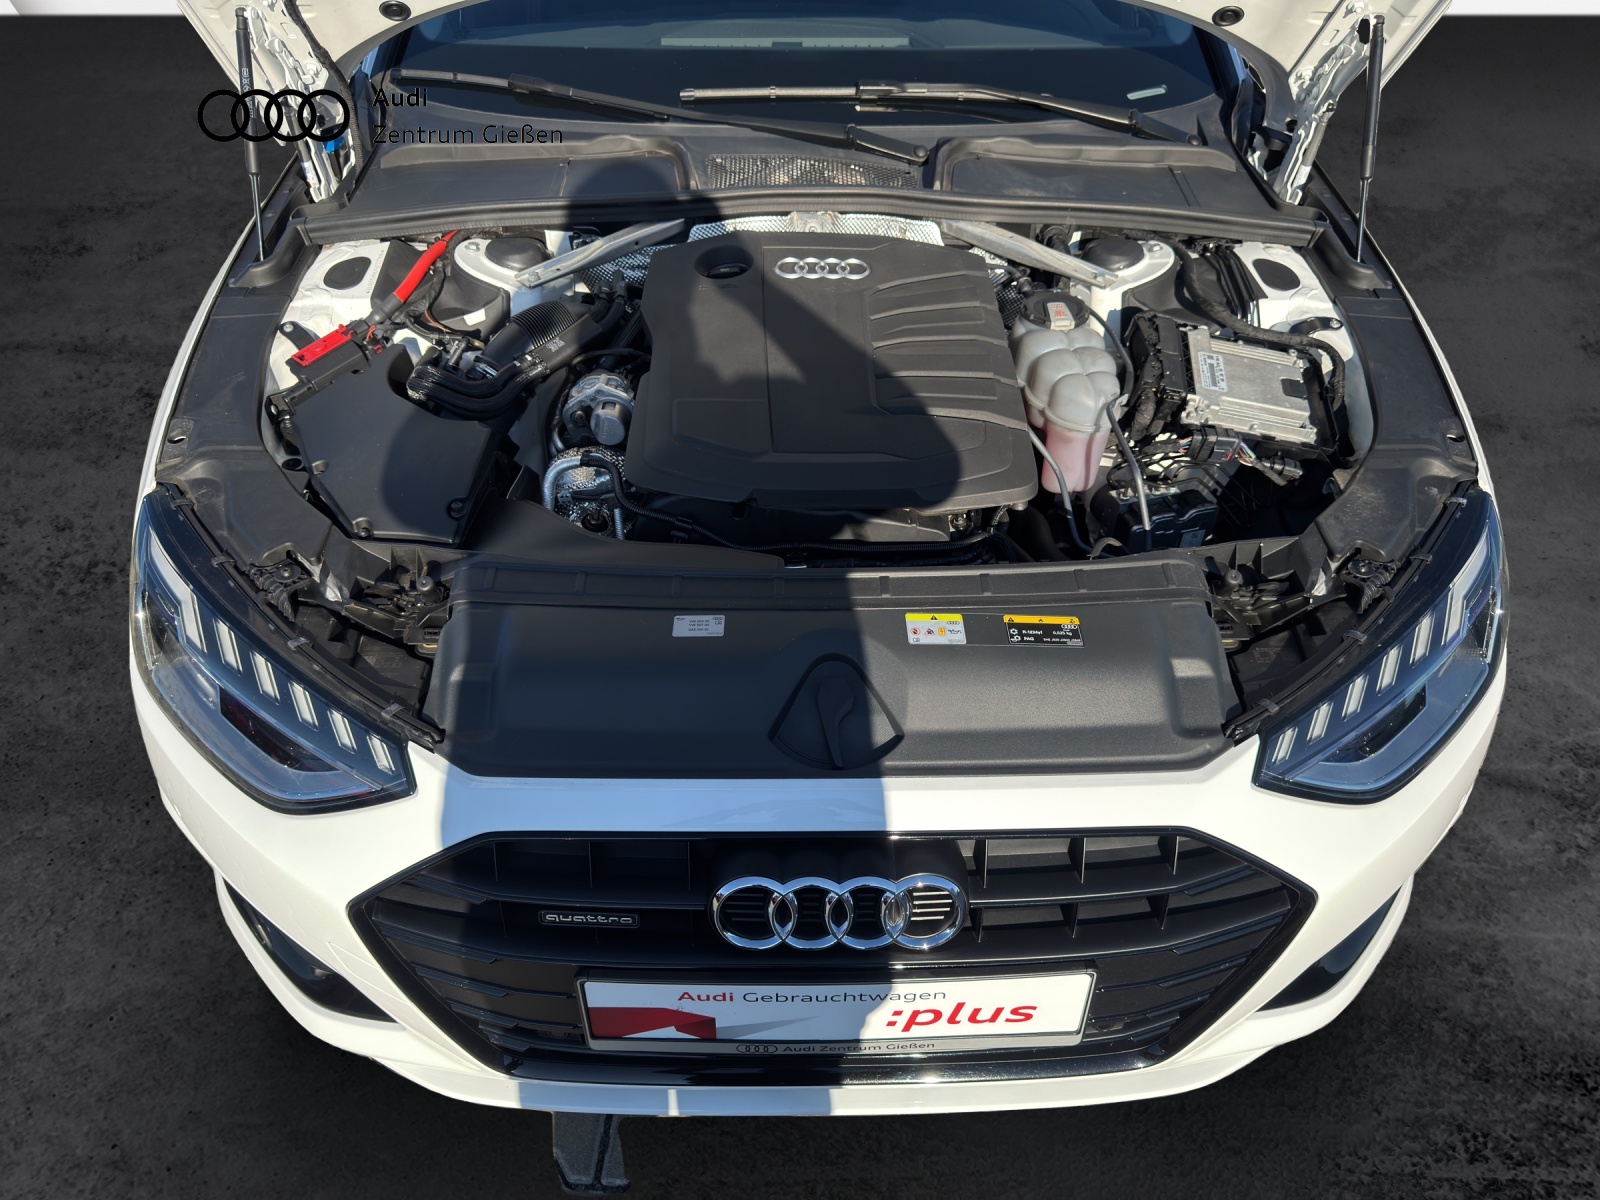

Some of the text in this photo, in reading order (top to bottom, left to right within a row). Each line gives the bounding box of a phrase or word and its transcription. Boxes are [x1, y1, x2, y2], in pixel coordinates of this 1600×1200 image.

[545, 914, 633, 924] quattro
[678, 991, 947, 1004] Audi Gebrauchtwagen
[886, 1002, 1038, 1032] :plus
[783, 1042, 935, 1053] Audi Zentrum Gießen
